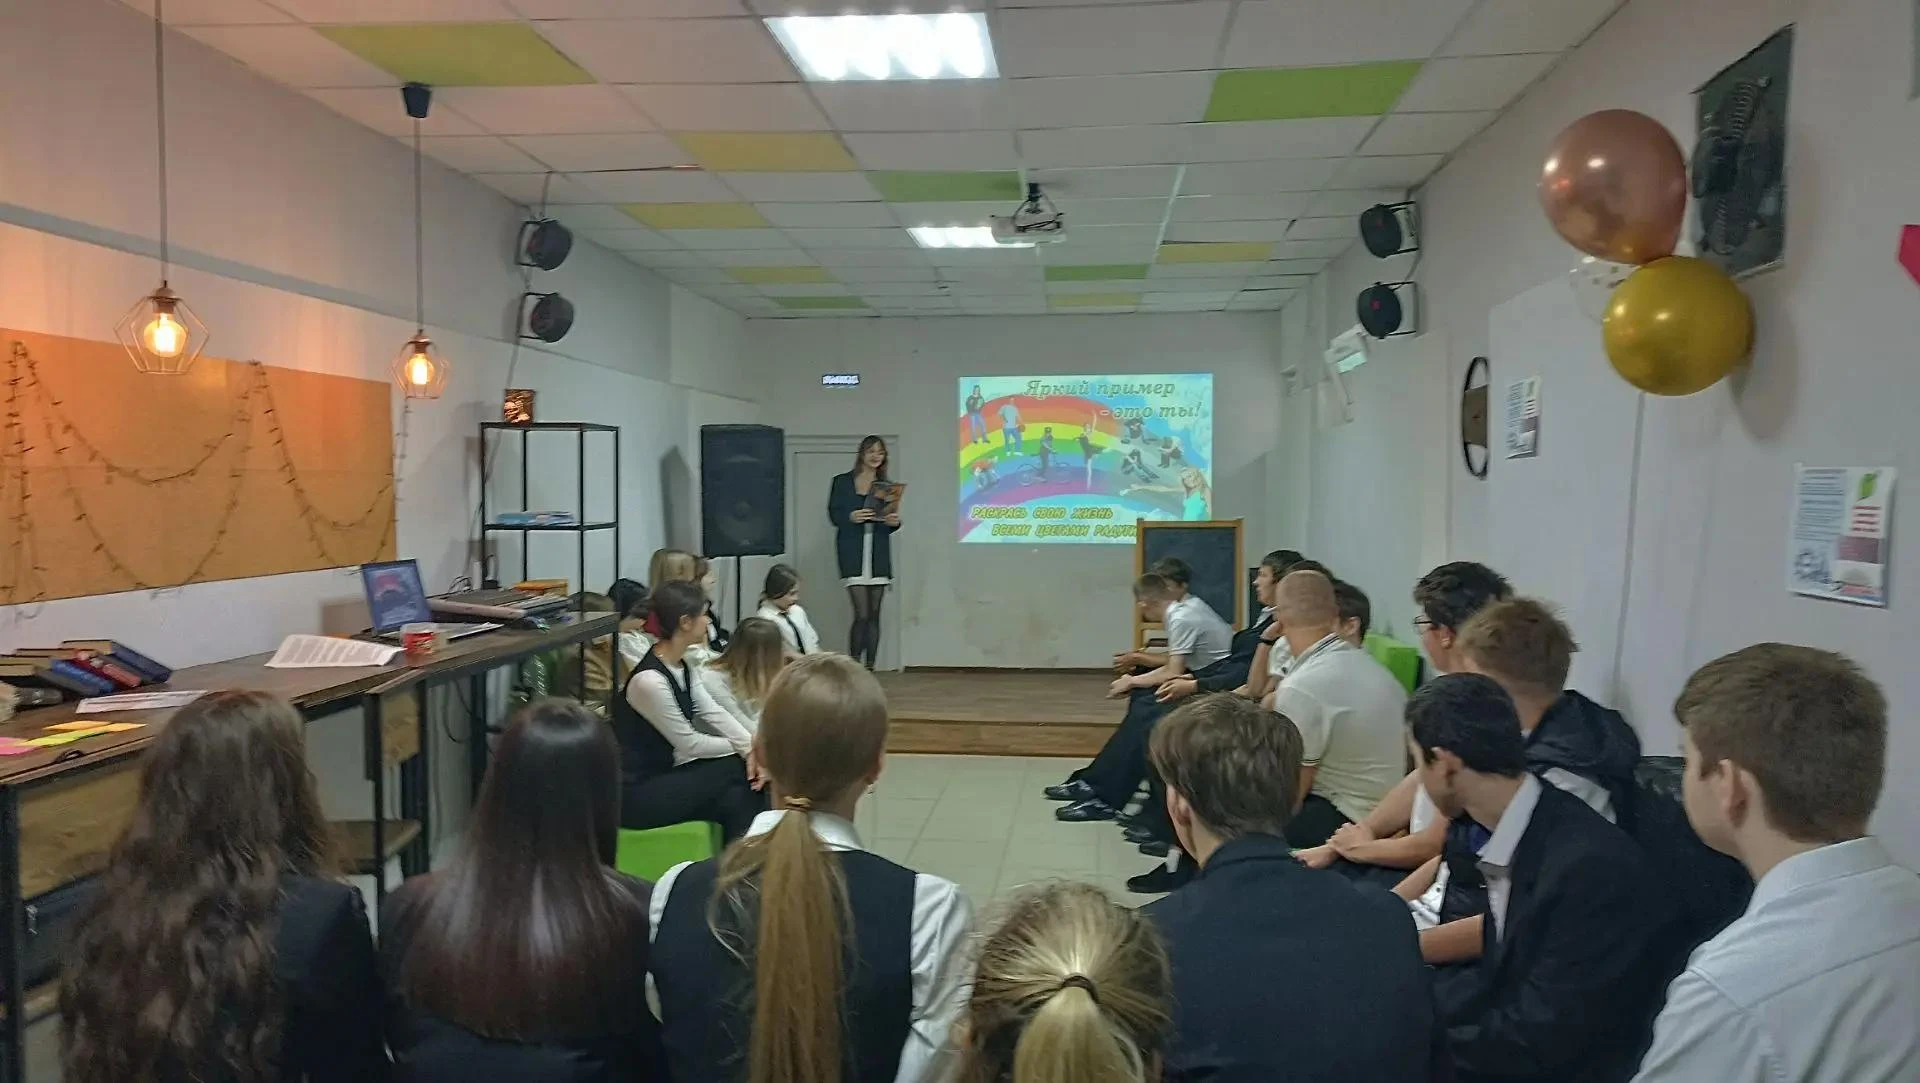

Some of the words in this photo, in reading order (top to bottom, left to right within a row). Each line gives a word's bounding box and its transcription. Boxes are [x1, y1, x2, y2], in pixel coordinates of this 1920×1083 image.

[1024, 379, 1089, 399] Яркий
[1096, 383, 1176, 398] пример
[1113, 406, 1153, 418] это
[1160, 402, 1202, 418] ты!
[971, 506, 1028, 519] РАСКРАСЬ
[1033, 506, 1066, 519] СВОЮ
[1071, 507, 1113, 519] ЖИЗНЬ
[992, 524, 1032, 536] ВСЕМИ
[1035, 524, 1090, 538] ЦВЕТАМИ
